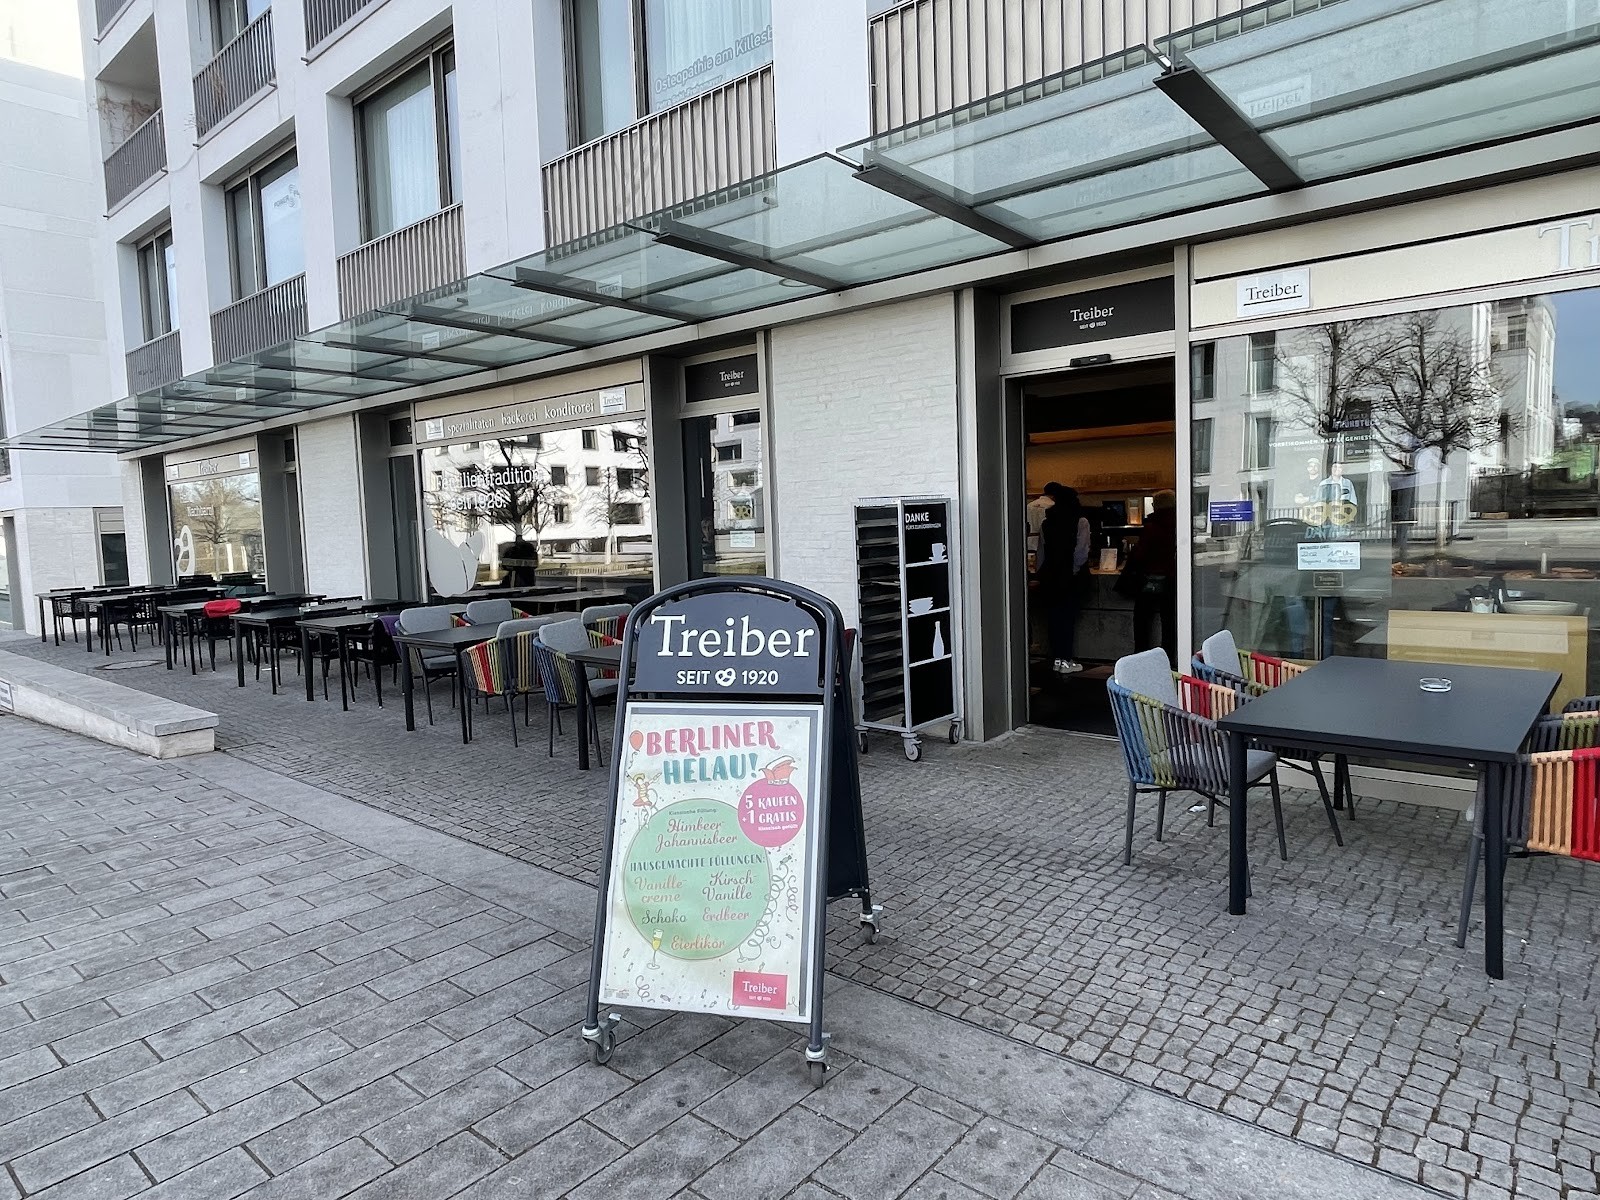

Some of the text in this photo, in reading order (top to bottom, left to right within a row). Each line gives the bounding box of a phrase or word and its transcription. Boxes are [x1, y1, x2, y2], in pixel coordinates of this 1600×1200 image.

[655, 56, 713, 94] Osteopathie
[715, 47, 734, 66] am
[1245, 281, 1300, 301] Treiber
[1070, 306, 1114, 321] Treiber
[719, 370, 744, 381] Treiber
[501, 407, 538, 426] bäckerei
[543, 398, 595, 420] konditorei
[905, 512, 930, 523] DANKE
[651, 614, 814, 658] Treiber
[676, 670, 779, 685] SEIT 1920
[646, 720, 781, 757] BERLINER
[663, 752, 759, 785] HELAU!
[745, 794, 798, 810] 5 KAUFEN
[758, 811, 797, 825] GRATIS
[655, 830, 738, 853] Johannisbeer
[630, 854, 766, 872] HAUSGEMACHTE FÜLLUNGEN:
[641, 893, 681, 904] creme
[702, 884, 753, 901] Vanille
[641, 907, 688, 924] Schoko
[702, 906, 751, 921] Erdbeer
[742, 980, 778, 995] Treiber
